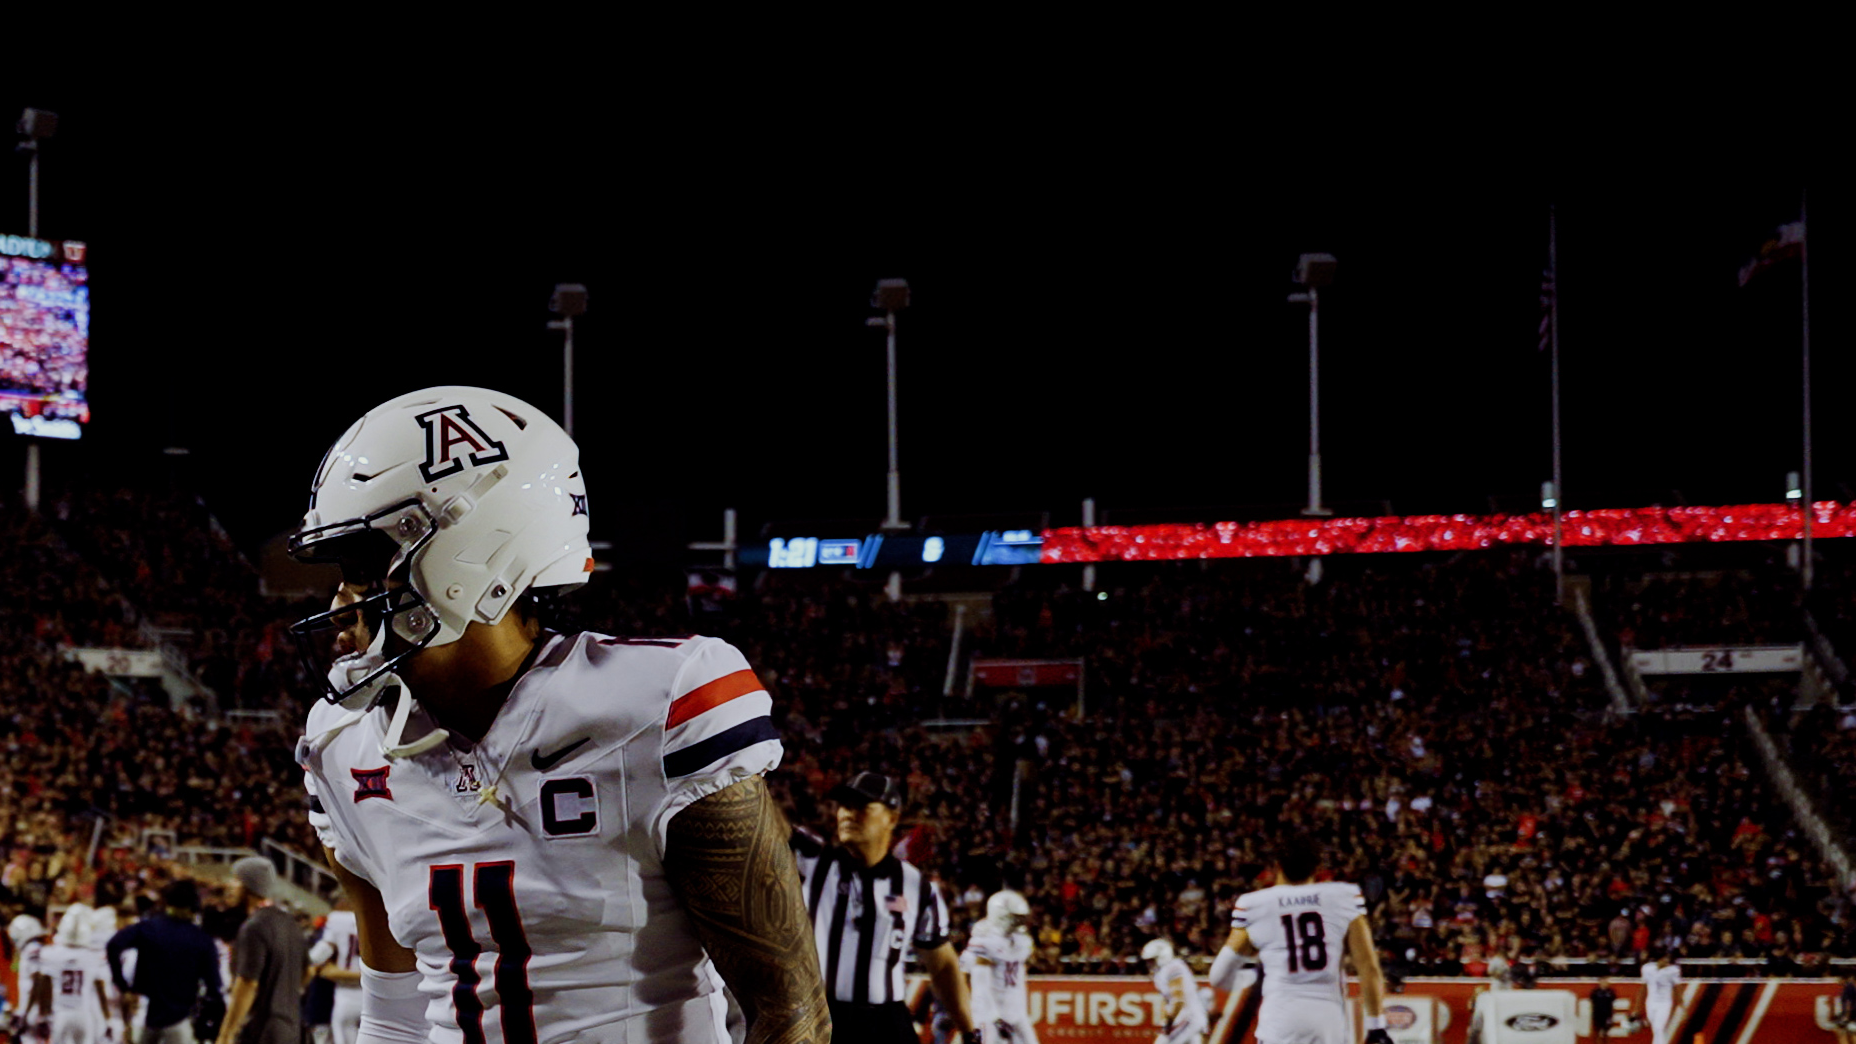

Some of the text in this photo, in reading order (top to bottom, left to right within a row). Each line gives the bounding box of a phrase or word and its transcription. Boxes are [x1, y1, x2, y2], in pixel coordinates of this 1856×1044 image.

[415, 405, 509, 484] A
[1702, 650, 1732, 671] 24
[540, 777, 597, 836] C
[1280, 912, 1327, 974] 18
